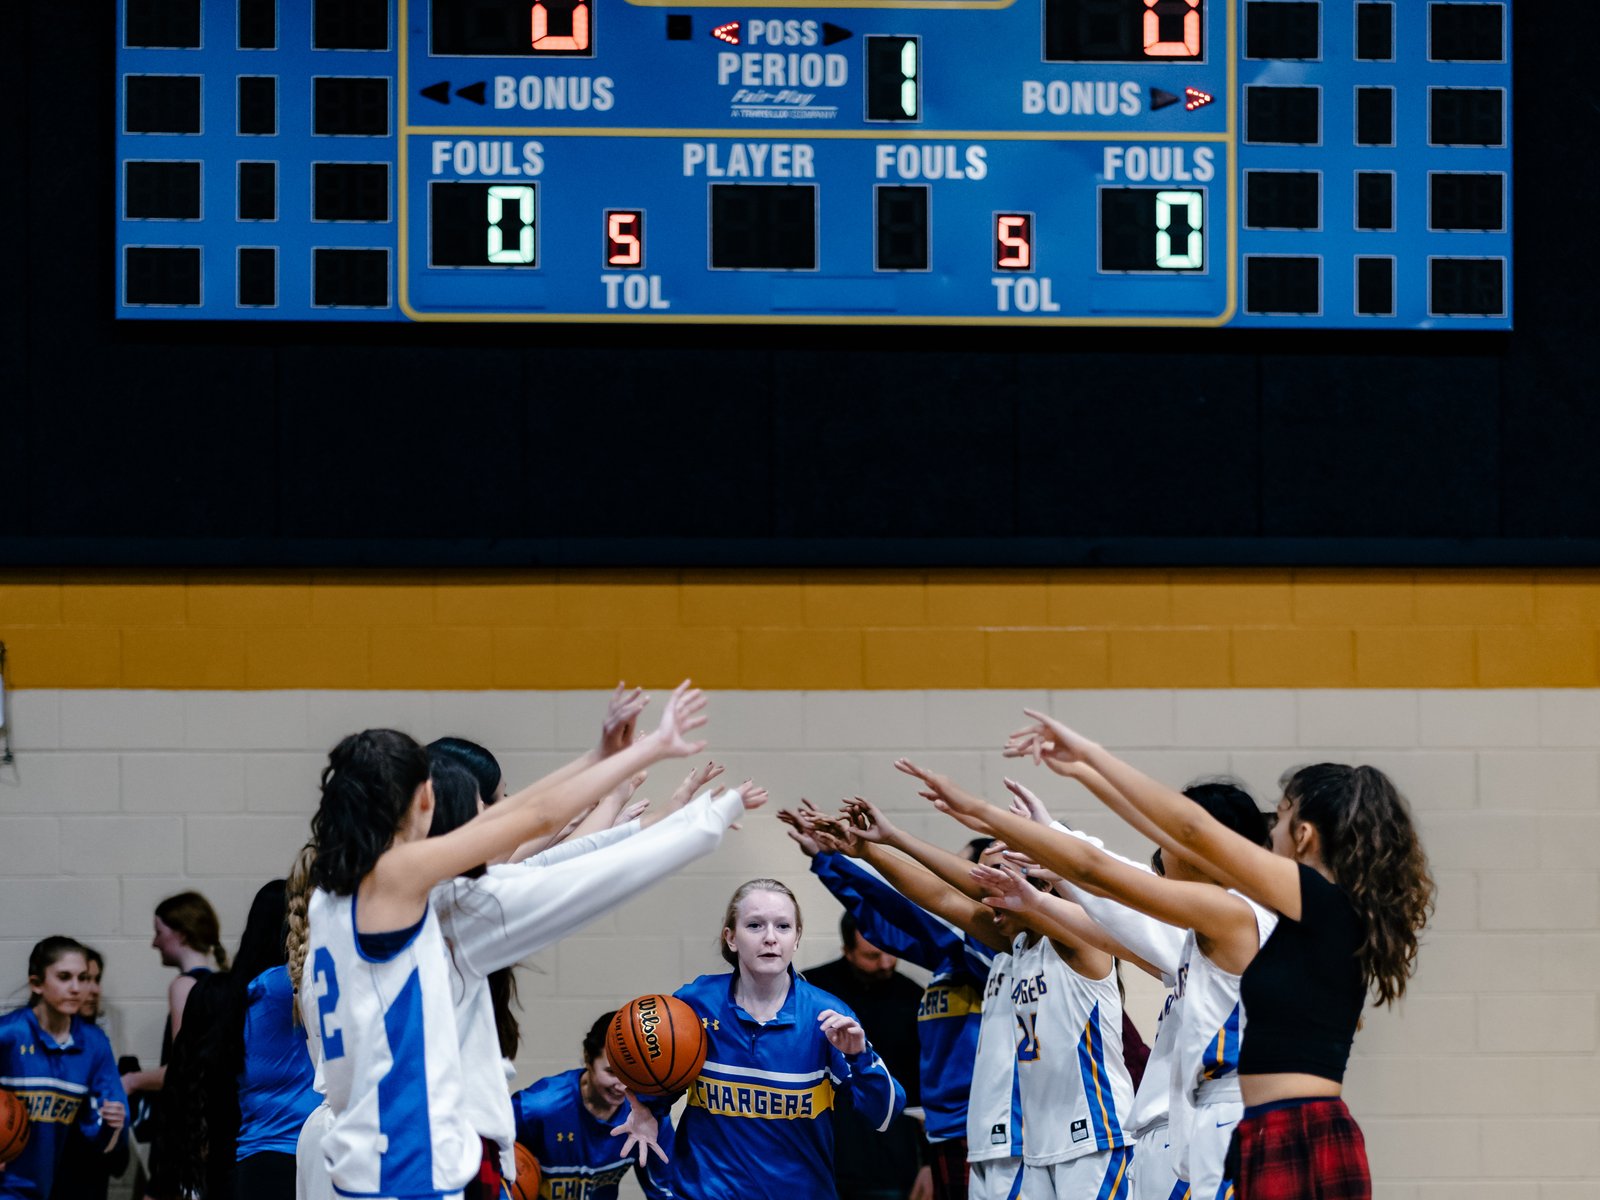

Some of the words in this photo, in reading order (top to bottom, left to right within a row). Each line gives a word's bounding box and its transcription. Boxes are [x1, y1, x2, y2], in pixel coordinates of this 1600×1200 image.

[747, 19, 818, 46] POSS
[718, 52, 848, 87] PERIOD
[901, 40, 917, 117] 1
[494, 76, 615, 111] BONUS
[1022, 80, 1142, 116] BONUS
[432, 141, 545, 176] FOULS
[683, 143, 815, 178] PLAYER
[875, 145, 987, 180] FOULS
[1104, 147, 1215, 182] FOULS
[487, 185, 535, 264] 0
[608, 213, 640, 265] 5
[998, 216, 1029, 268] 5
[1156, 191, 1203, 269] 0
[601, 275, 670, 309] TOL
[991, 278, 1060, 312] TOL
[313, 946, 346, 1061] 2
[638, 997, 662, 1060] Wilson
[695, 1080, 814, 1117] CHARGERS
